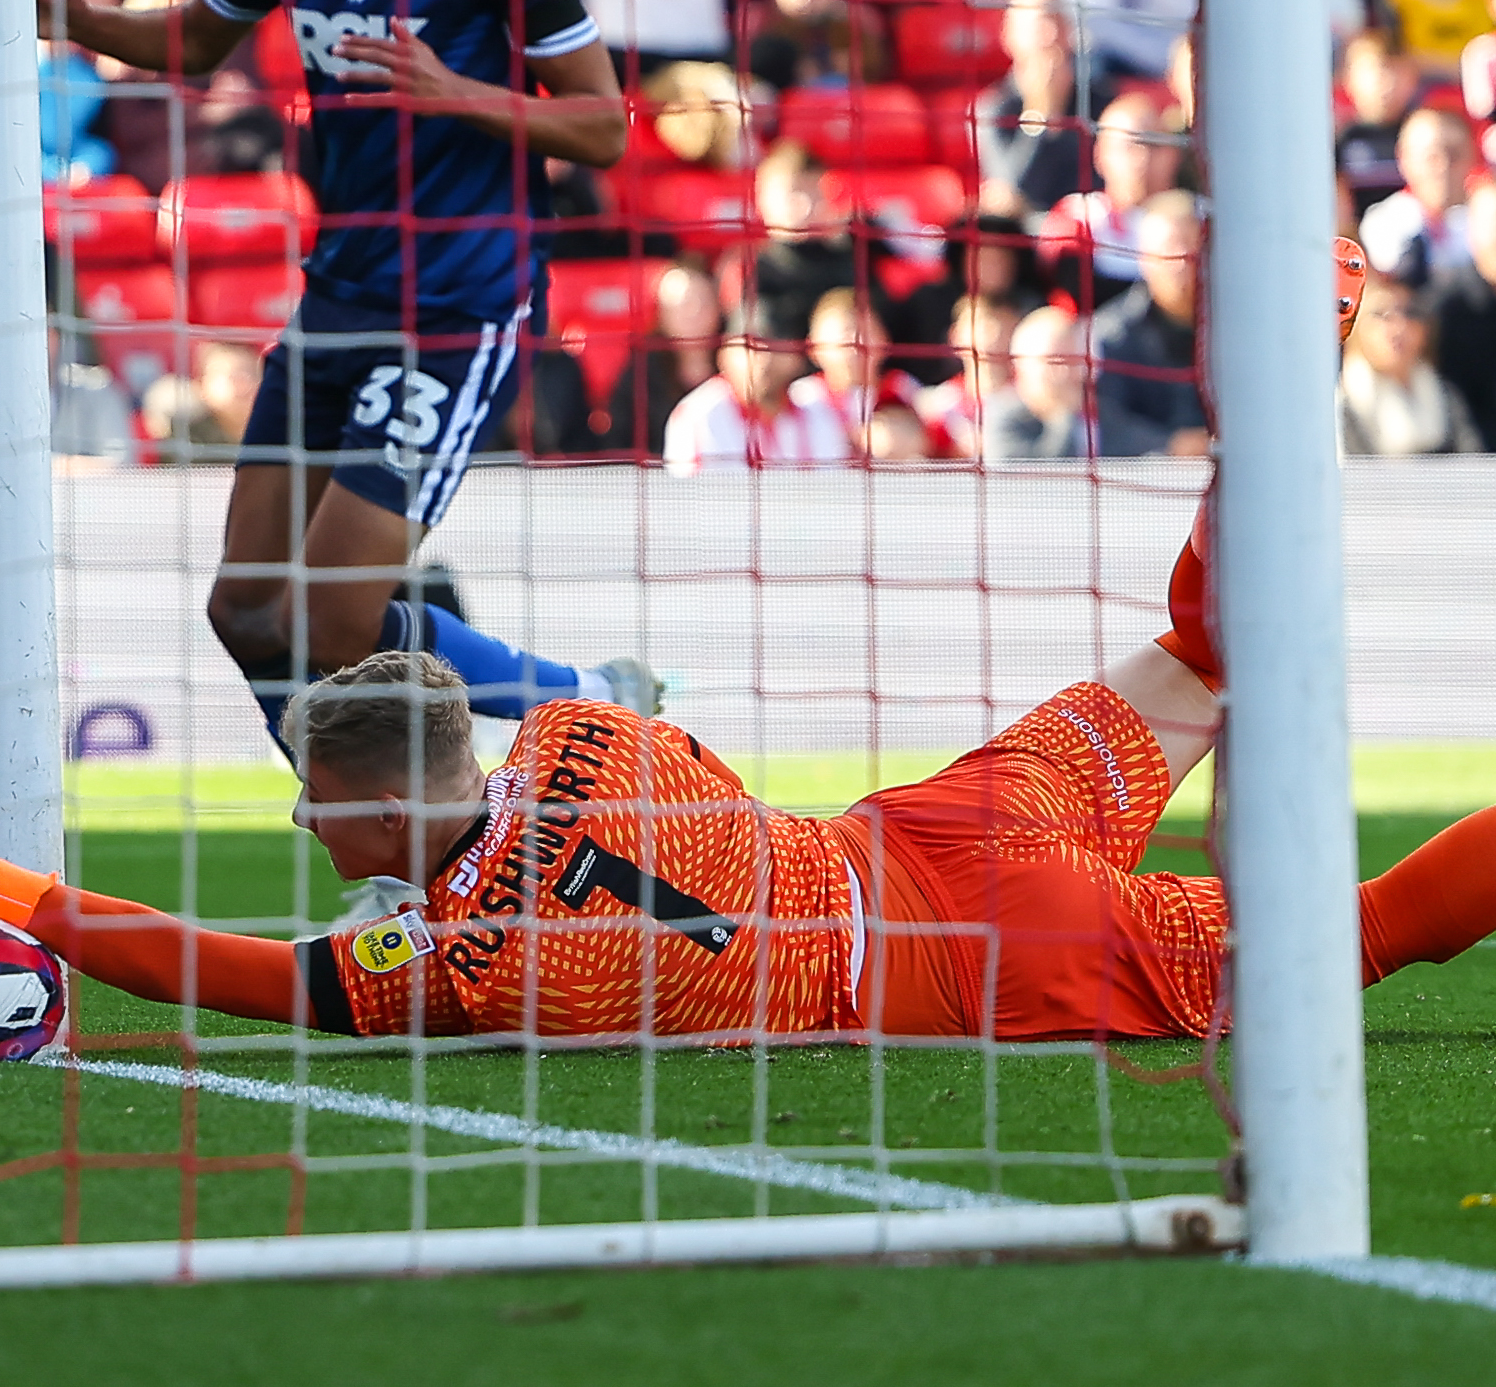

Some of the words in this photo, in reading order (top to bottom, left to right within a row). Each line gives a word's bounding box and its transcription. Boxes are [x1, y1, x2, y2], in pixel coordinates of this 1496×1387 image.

[353, 364, 450, 447] 33
[1057, 708, 1130, 811] nicholsons
[443, 718, 615, 985] RUSHWORTH
[552, 834, 740, 956] 1
